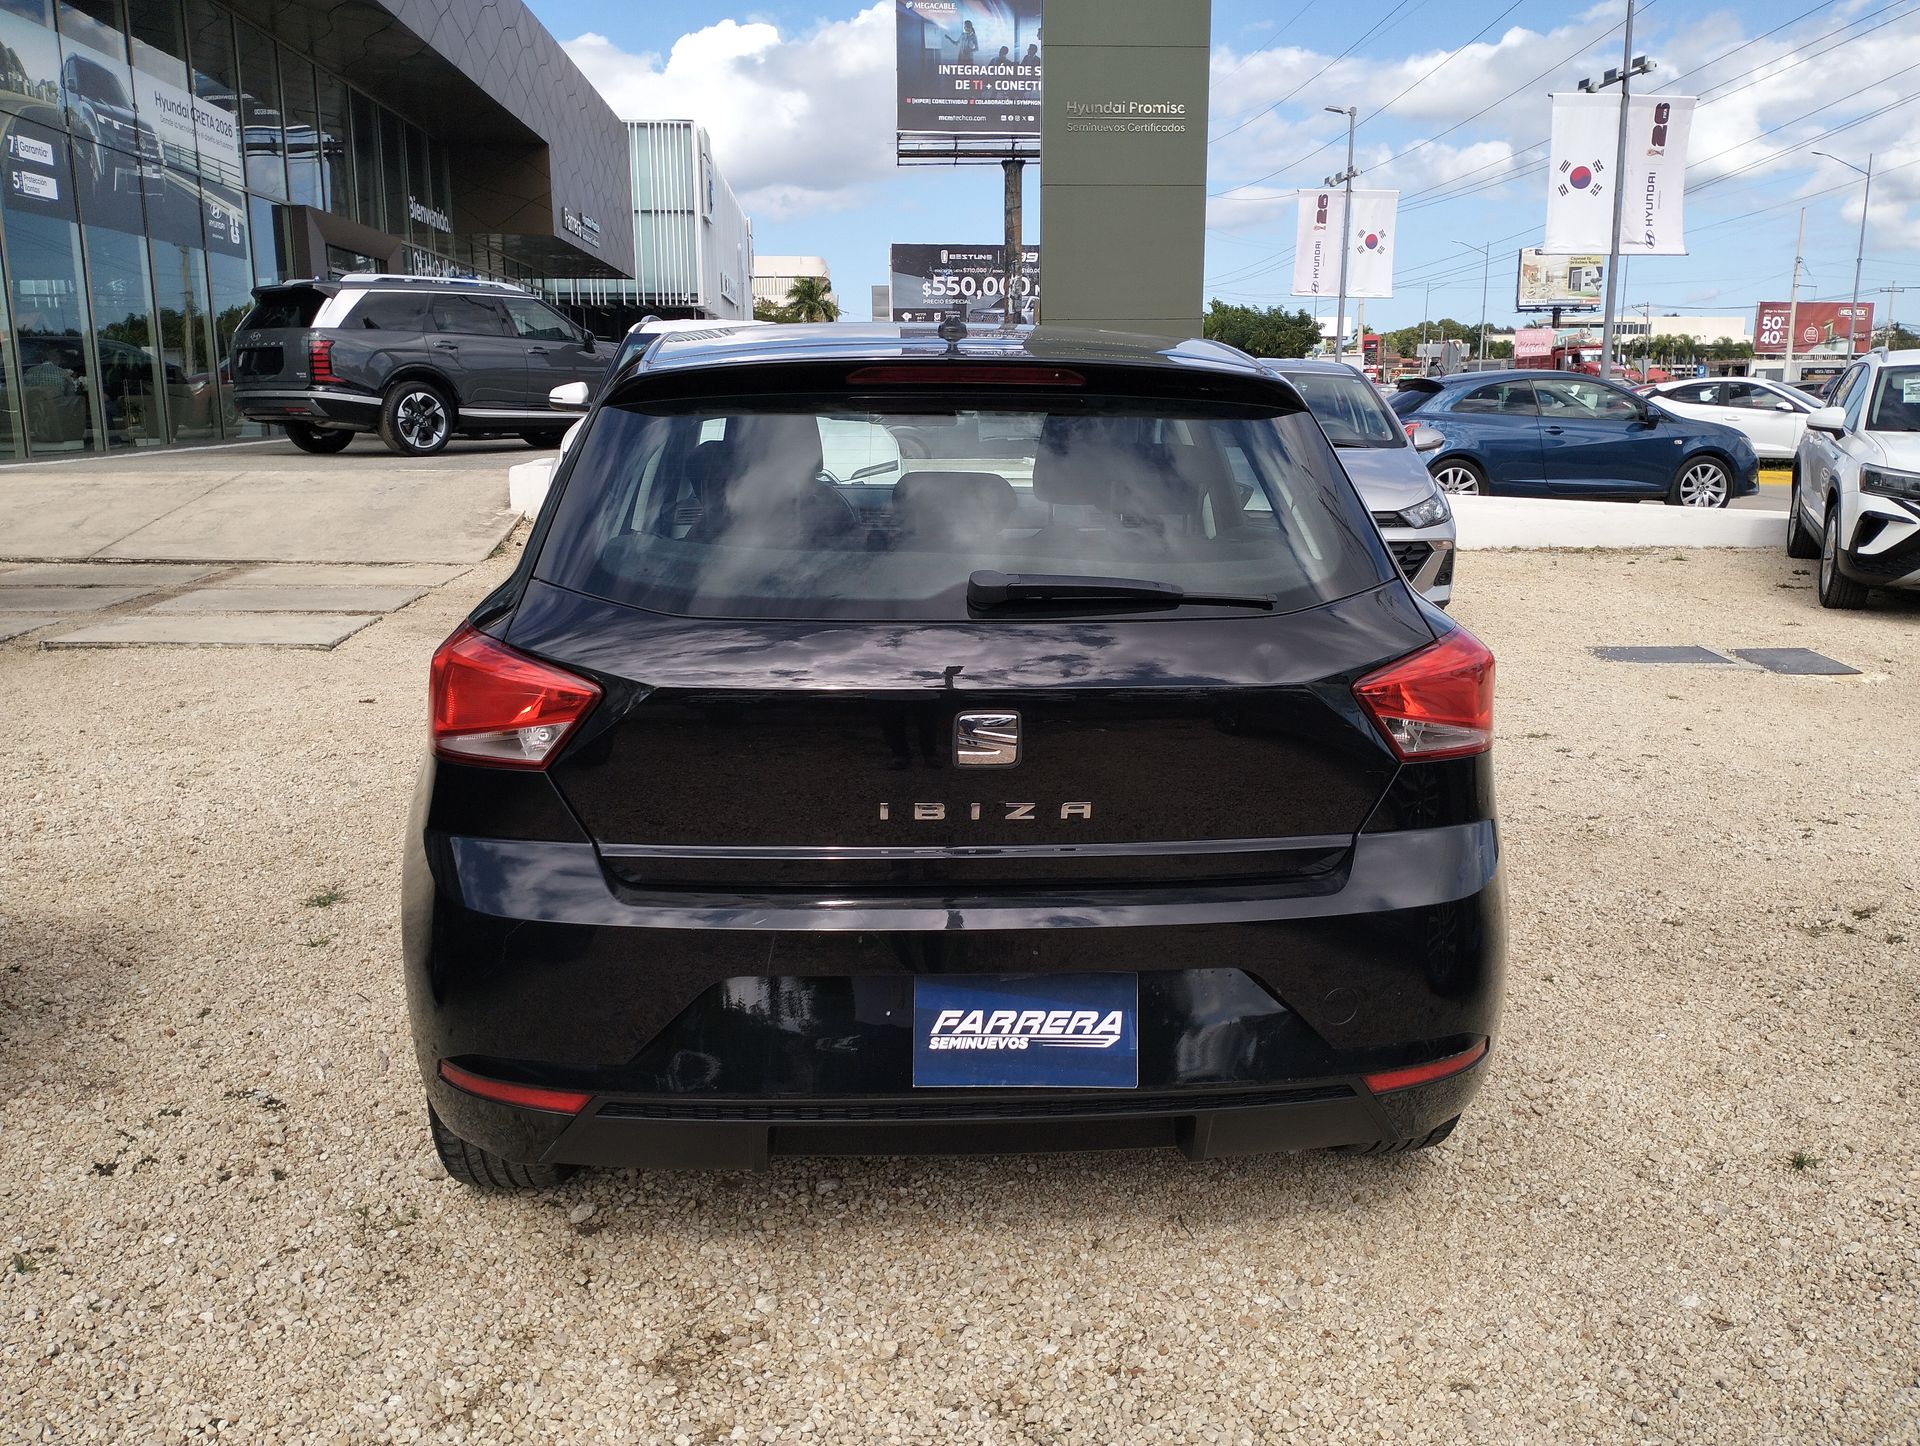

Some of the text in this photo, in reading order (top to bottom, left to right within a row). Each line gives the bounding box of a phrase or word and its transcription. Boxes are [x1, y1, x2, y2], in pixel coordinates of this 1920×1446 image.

[938, 64, 1014, 76] INTEGRACIÓN
[1017, 65, 1032, 76] DE
[955, 80, 970, 90] DE
[973, 80, 983, 90] TI
[154, 90, 189, 119] Hyundai
[214, 117, 234, 139] 2026
[1066, 101, 1186, 116] Hyundai Promise
[1066, 122, 1186, 132] Seminuevos Certificados
[7, 135, 14, 152] 7
[13, 171, 20, 189] 5
[1645, 171, 1656, 227] HYUNDAI
[1313, 240, 1322, 279] HYUNDAI
[879, 802, 1092, 820] IBIZA
[930, 1010, 1123, 1034] FARRERA
[928, 1037, 1029, 1050] SEMINUEVOS
